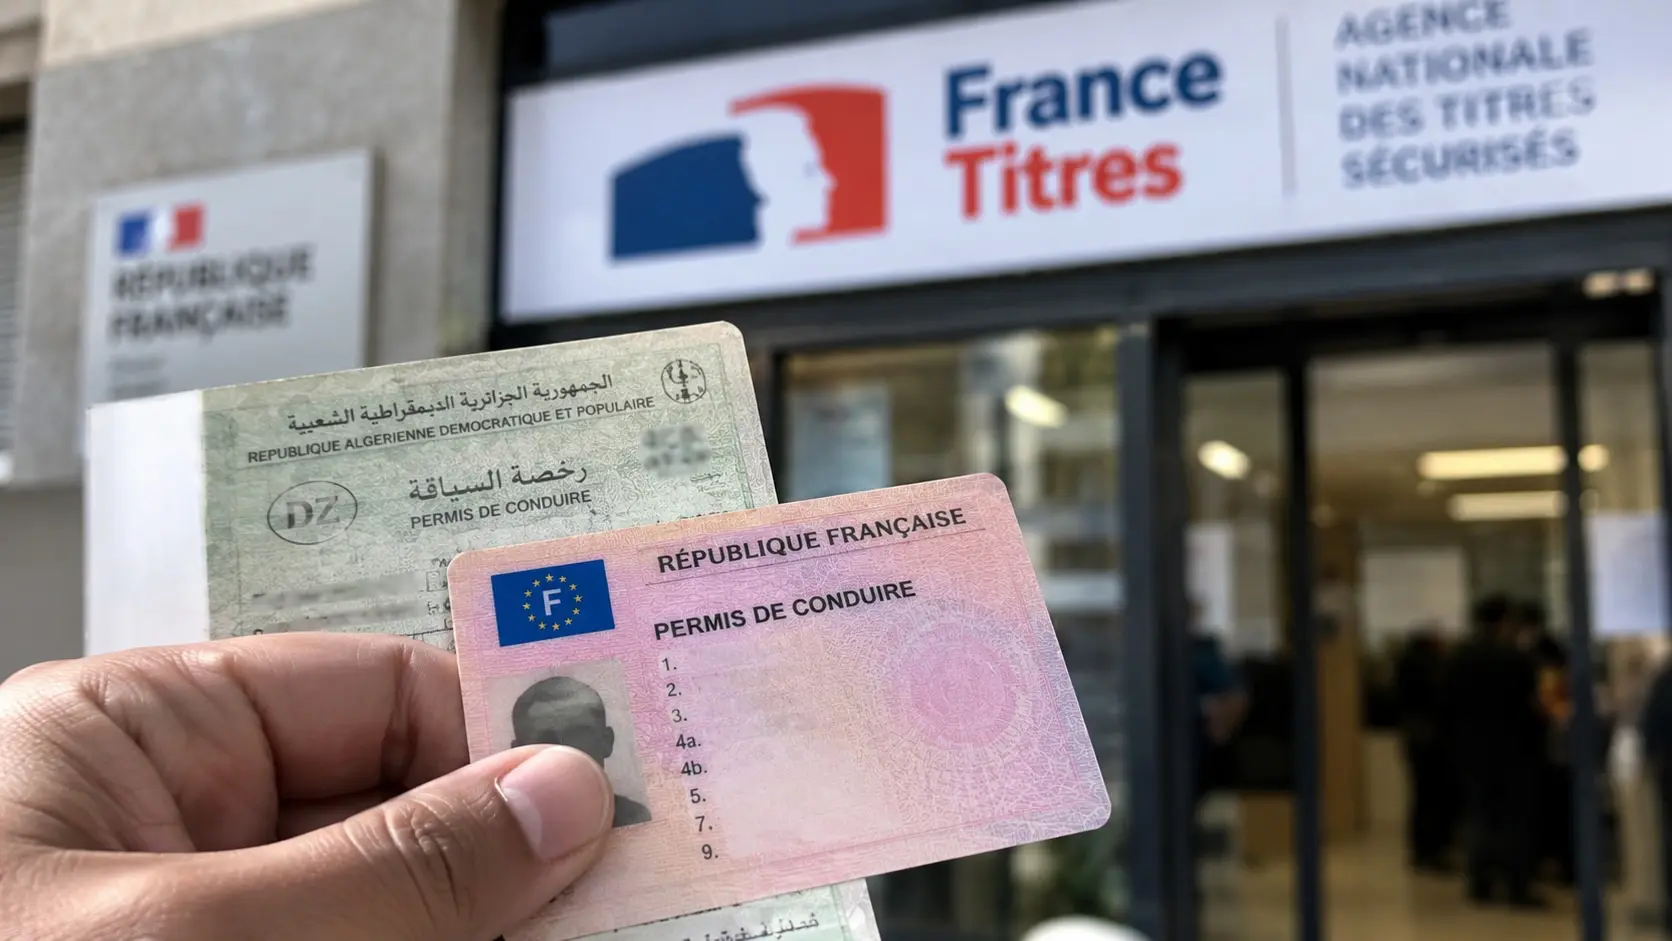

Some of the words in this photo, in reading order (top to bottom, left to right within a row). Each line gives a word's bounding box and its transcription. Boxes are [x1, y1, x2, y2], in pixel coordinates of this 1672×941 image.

[1334, 0, 1513, 49] AGENCE
[1336, 27, 1594, 94] NATIONALE
[945, 49, 1221, 138] France
[1339, 98, 1424, 141] DES
[1436, 76, 1596, 130] TITRES
[1341, 125, 1579, 188] SÉCURISÉS
[944, 140, 1183, 221] Titres
[247, 440, 341, 463] REPUBLIQUE
[344, 427, 435, 450] ALGERIENNE
[439, 410, 552, 436] DEMOCRATIQUE
[555, 407, 572, 420] ET
[577, 396, 655, 417] POPULAIRE
[409, 469, 502, 502] السياقة
[511, 460, 587, 485] رخصة
[286, 495, 340, 529] DZ
[410, 508, 474, 529] PERMIS
[479, 504, 501, 518] DE
[505, 490, 592, 514] CONDUIRE
[657, 531, 821, 573] RÉPUBLIQUE
[826, 508, 967, 546] FRANÇAISE
[543, 588, 561, 616] F
[654, 610, 746, 640] PERMIS
[753, 602, 787, 624] DE
[792, 580, 916, 617] CONDUIRE
[662, 657, 677, 671] 1.
[666, 682, 682, 697] 2.
[671, 708, 687, 723] 3.
[675, 734, 701, 749] 4a.
[681, 760, 707, 776] 4b.
[690, 788, 706, 804] 5.
[695, 816, 713, 832] 7.
[701, 844, 718, 860] 9.
